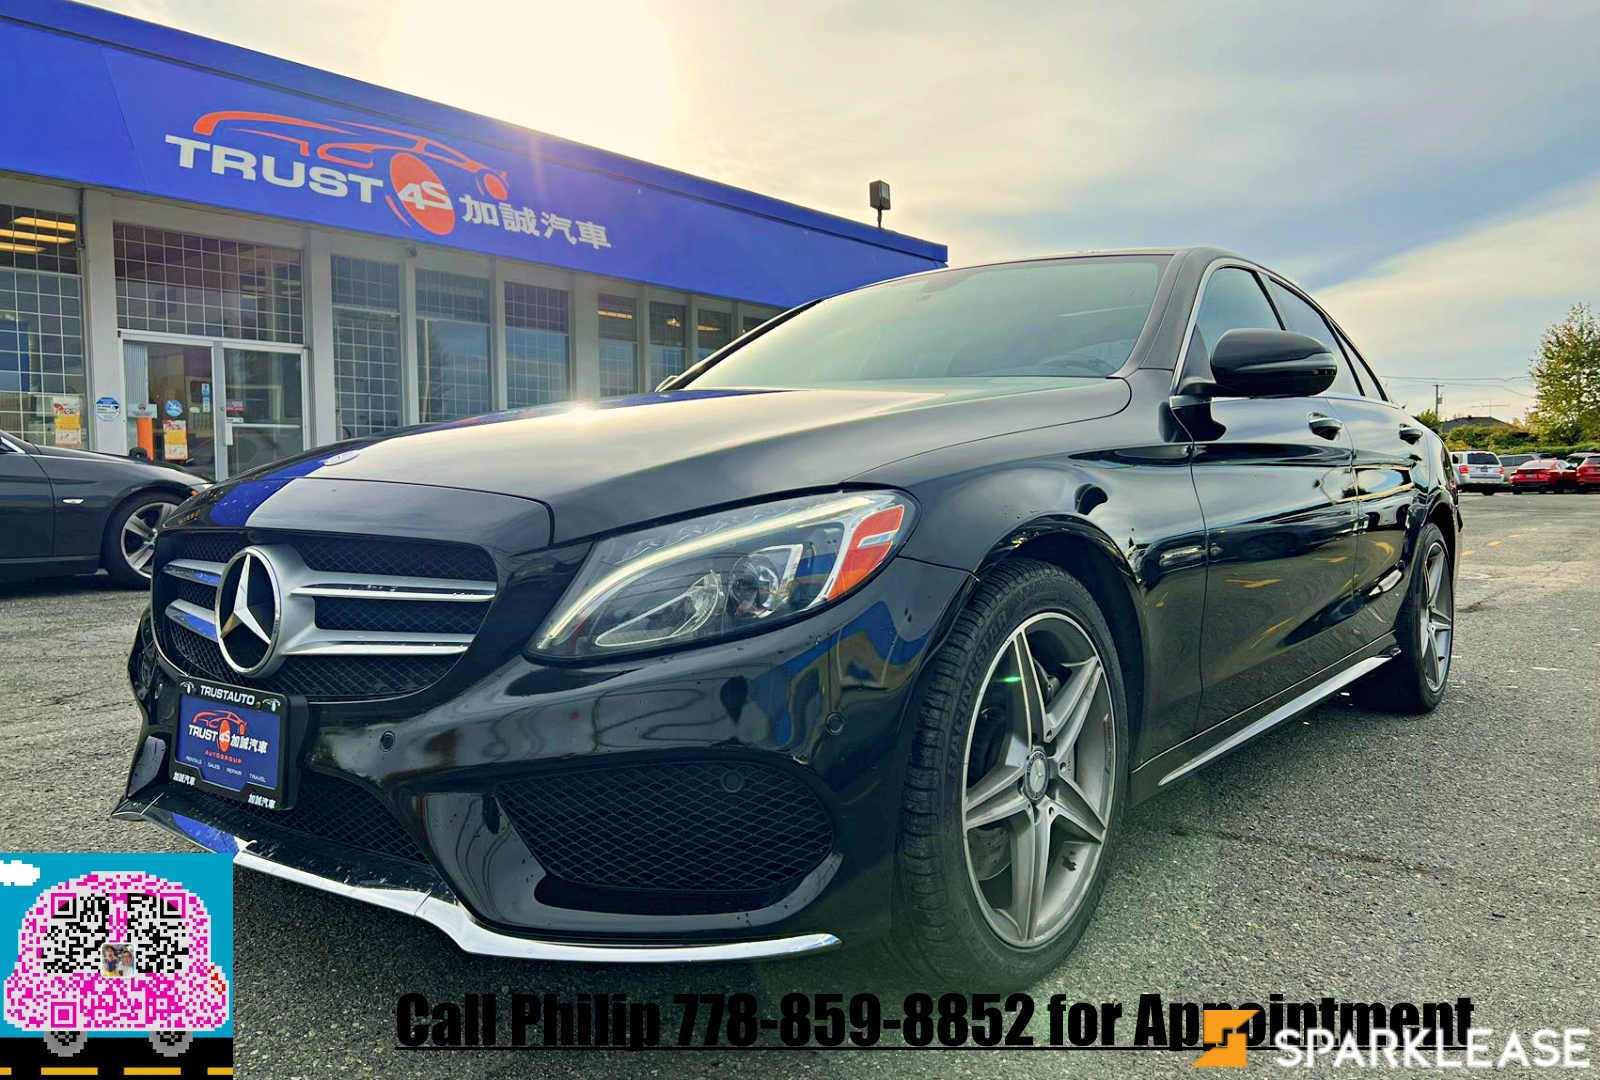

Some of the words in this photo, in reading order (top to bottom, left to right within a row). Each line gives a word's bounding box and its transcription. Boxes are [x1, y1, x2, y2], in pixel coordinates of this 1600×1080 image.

[165, 134, 384, 204] TRUST
[399, 181, 454, 210] 4S
[458, 193, 612, 250] 加誠汽車
[200, 685, 255, 705] TRUSTAUTO
[188, 725, 218, 742] TRUST
